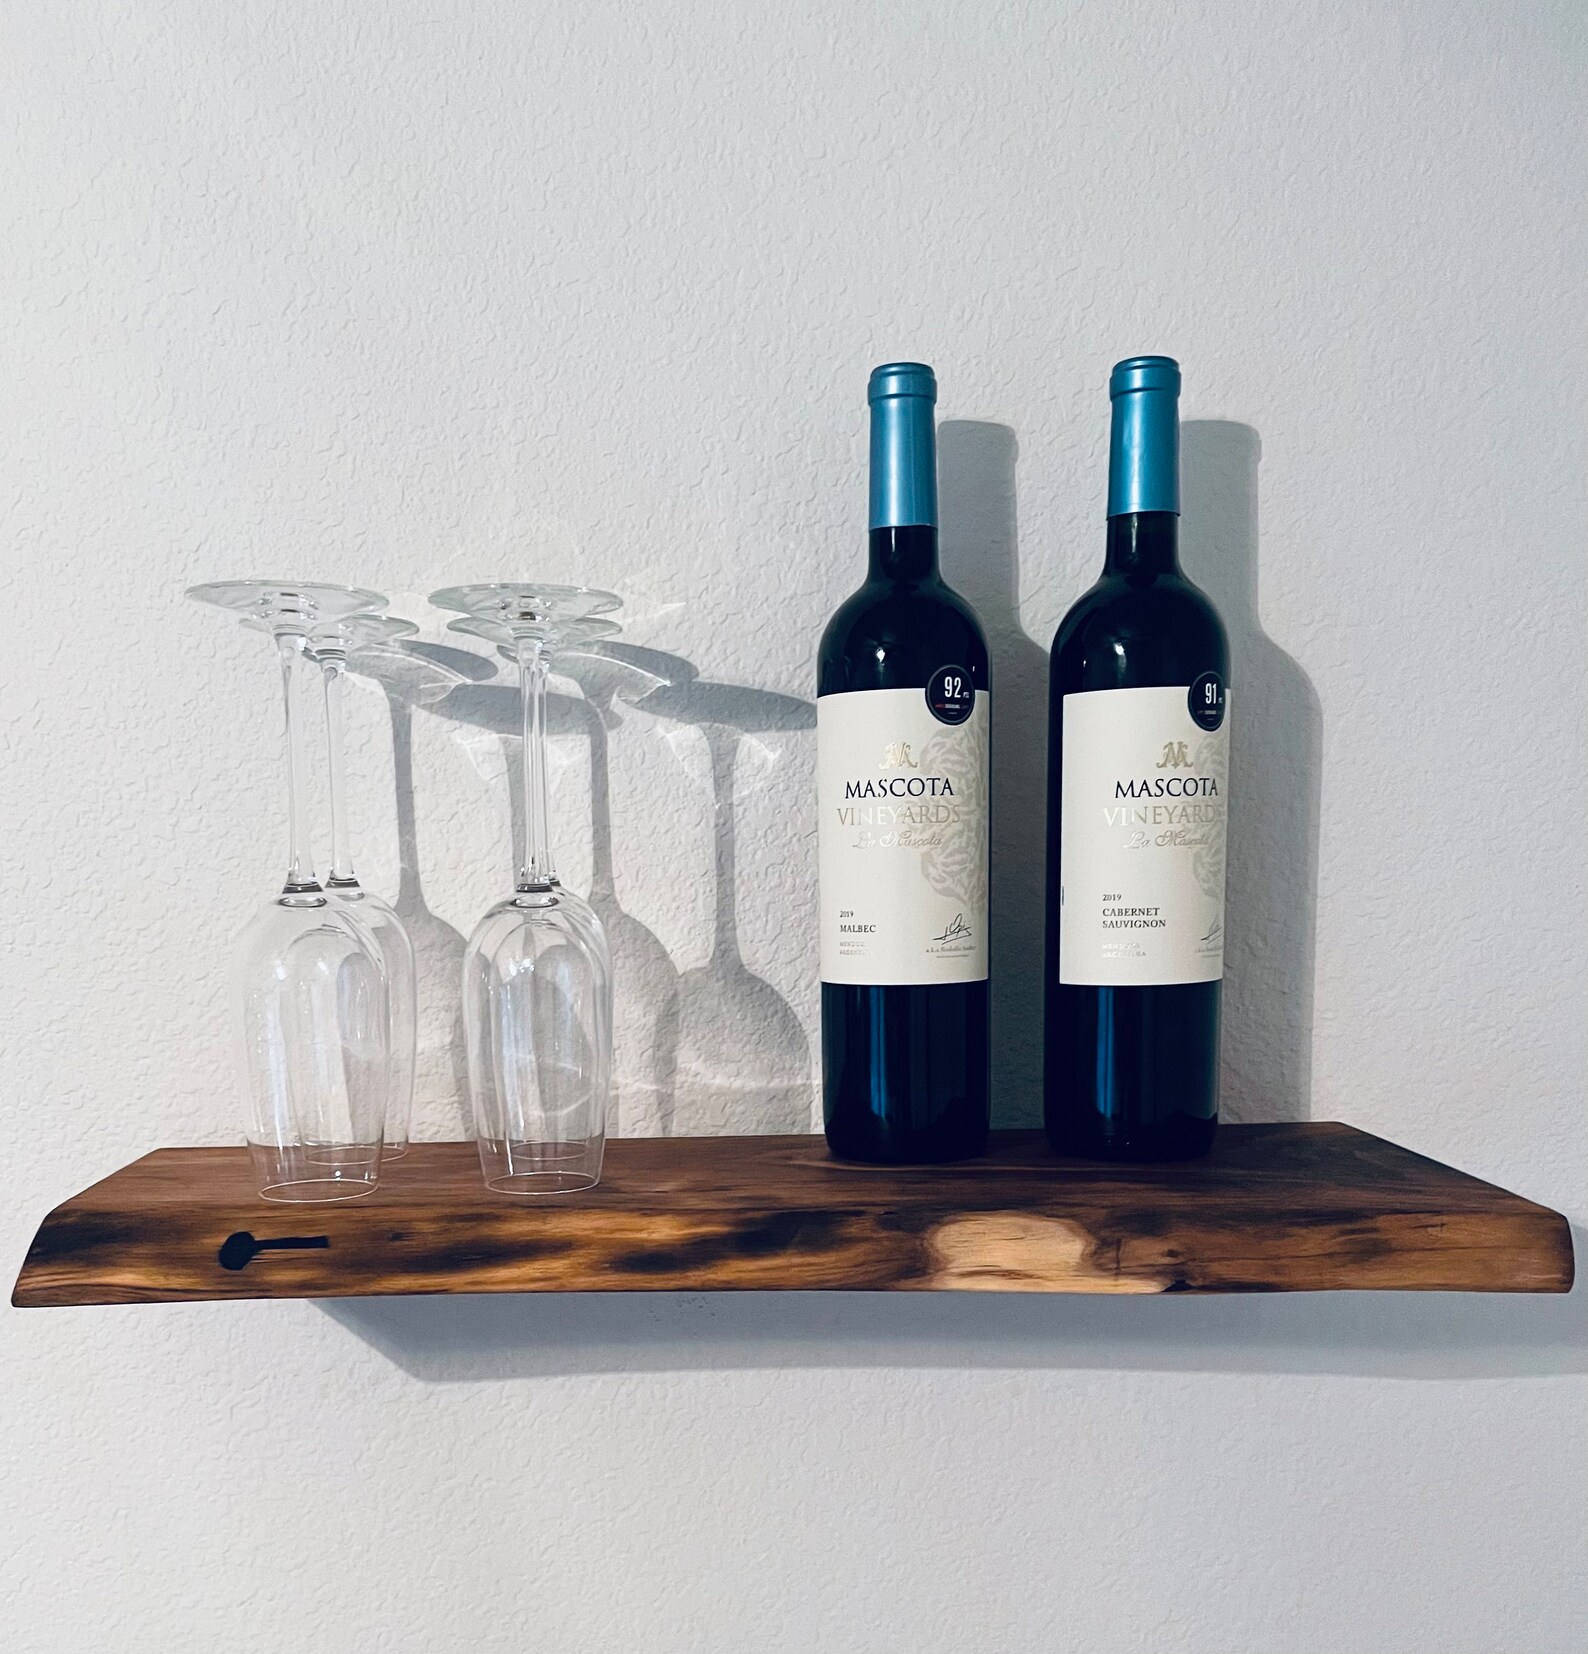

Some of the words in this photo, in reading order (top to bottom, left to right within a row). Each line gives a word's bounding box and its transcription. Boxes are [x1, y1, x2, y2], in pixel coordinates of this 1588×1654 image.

[944, 676, 962, 698] 92
[1205, 683, 1217, 705] 91
[844, 777, 955, 799] MASCOTA
[1114, 777, 1219, 799] MASCOTA
[837, 804, 961, 827] VINEYARDS
[852, 831, 877, 850] La
[879, 830, 944, 849] Mascota
[1122, 831, 1151, 849] La
[1102, 893, 1122, 902] 2019
[839, 910, 855, 919] 2019
[1102, 907, 1161, 917] CABERNET
[839, 924, 877, 934] MALBEC
[1102, 919, 1167, 929] SAUVIGNON
